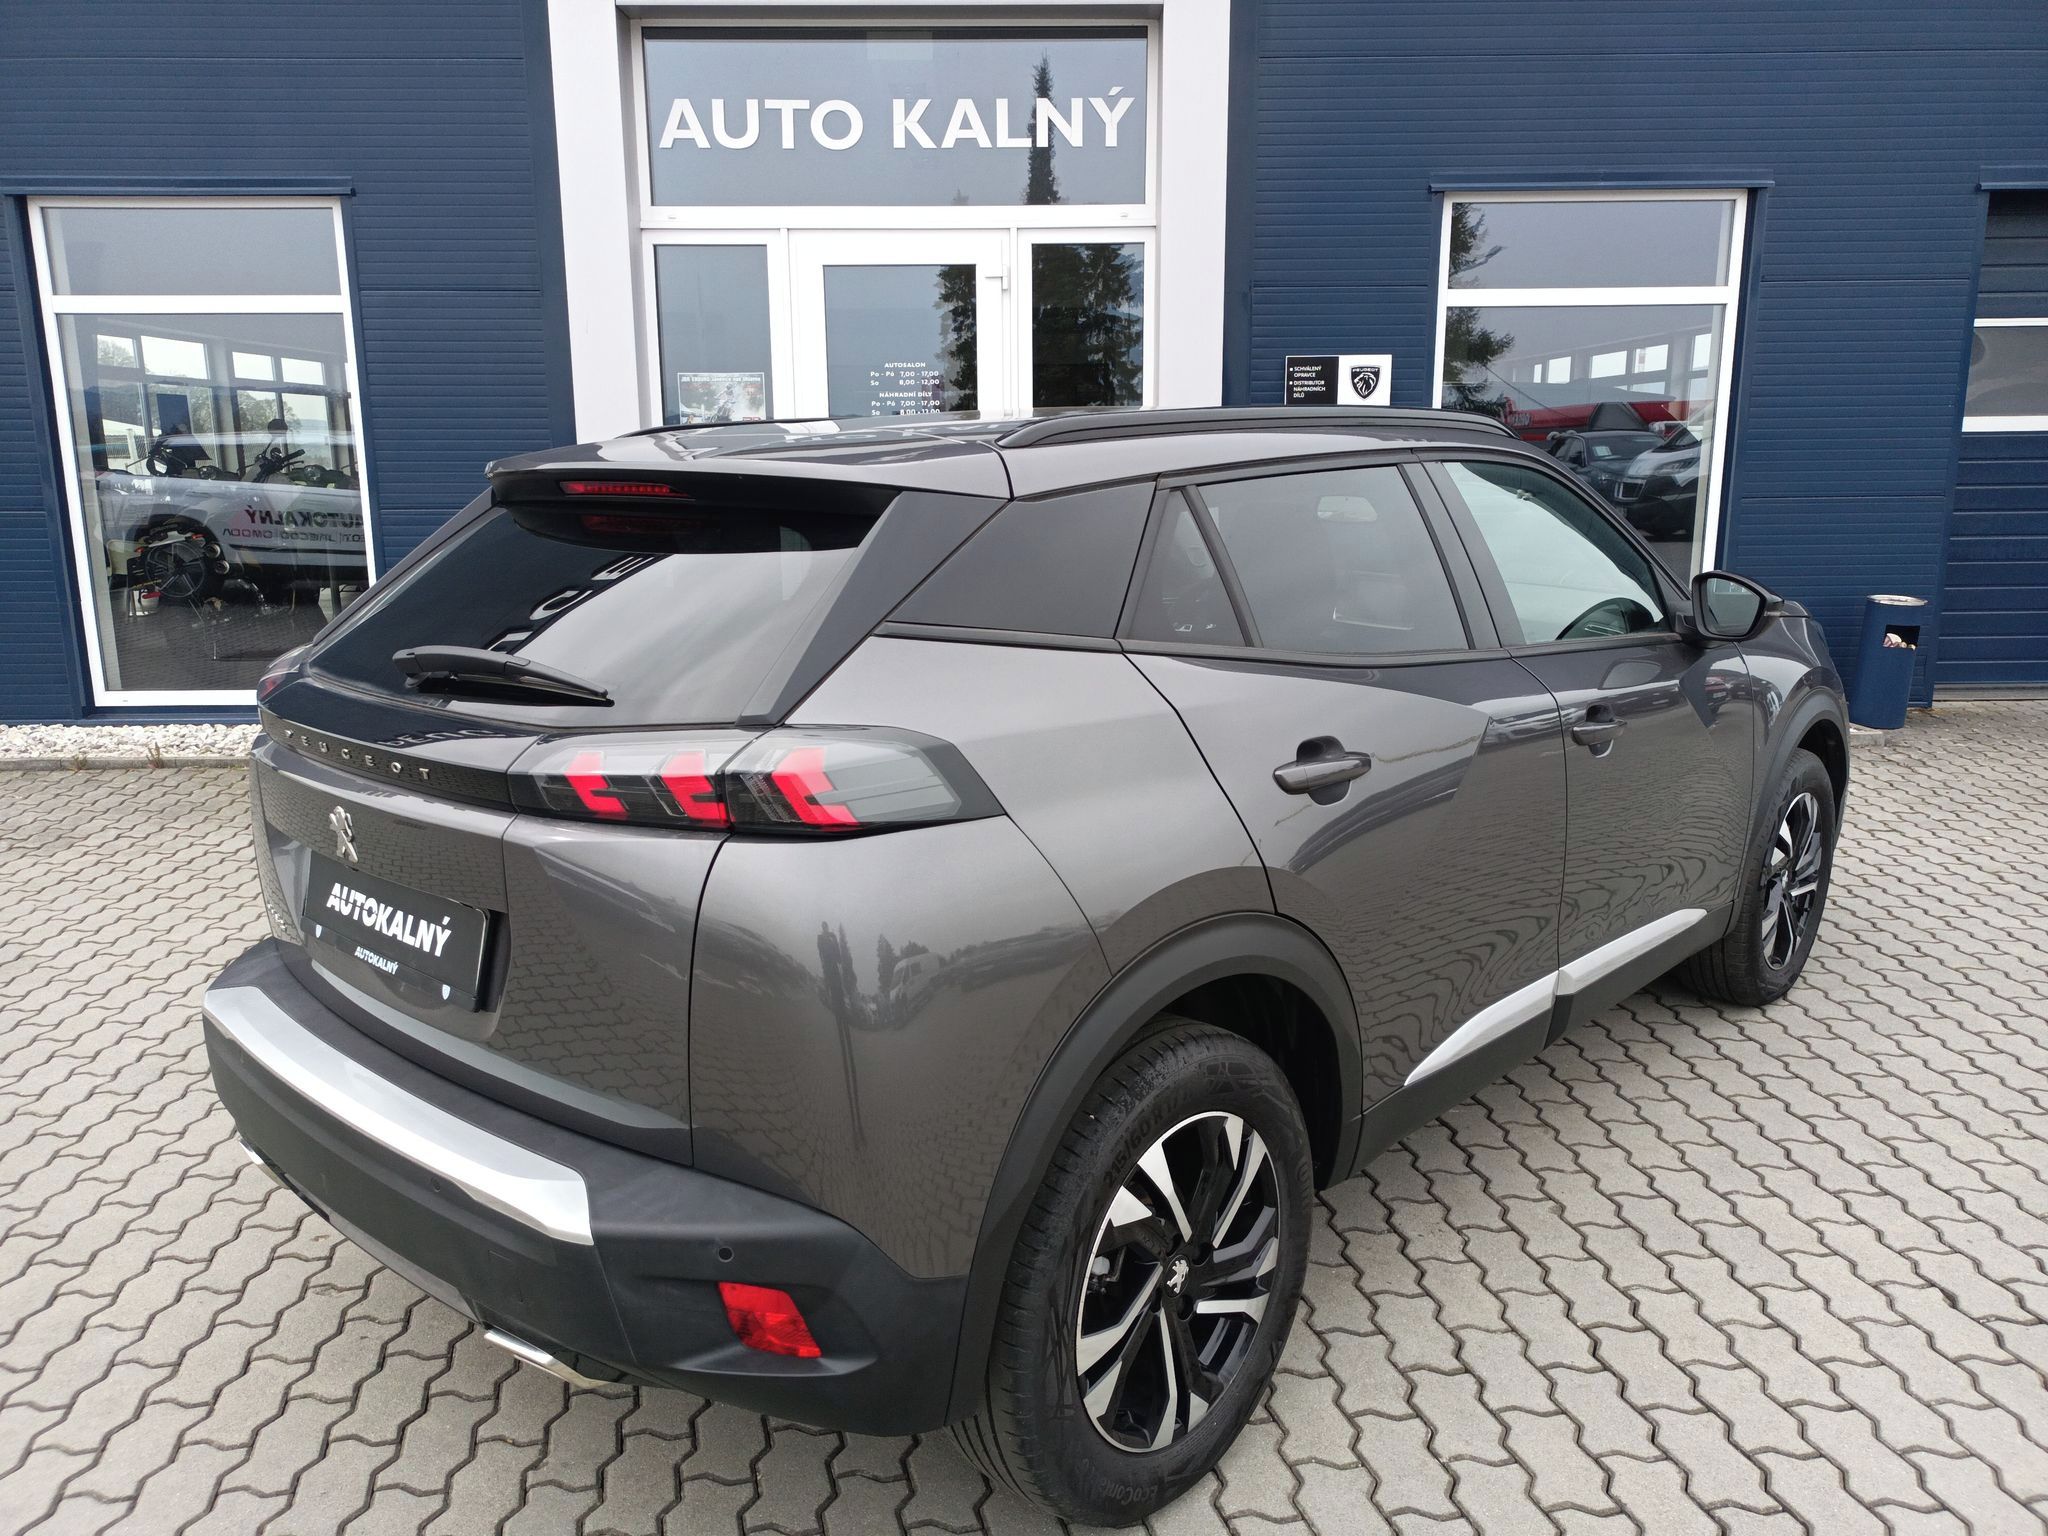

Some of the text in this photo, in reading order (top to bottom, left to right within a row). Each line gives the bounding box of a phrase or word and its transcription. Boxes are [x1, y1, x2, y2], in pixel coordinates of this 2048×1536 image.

[659, 86, 1136, 150] AUTO KALNÝ
[283, 729, 430, 780] PEUGEOT
[325, 882, 452, 957] AUTOKALNÝ
[353, 946, 400, 976] AUTOKALNÝ
